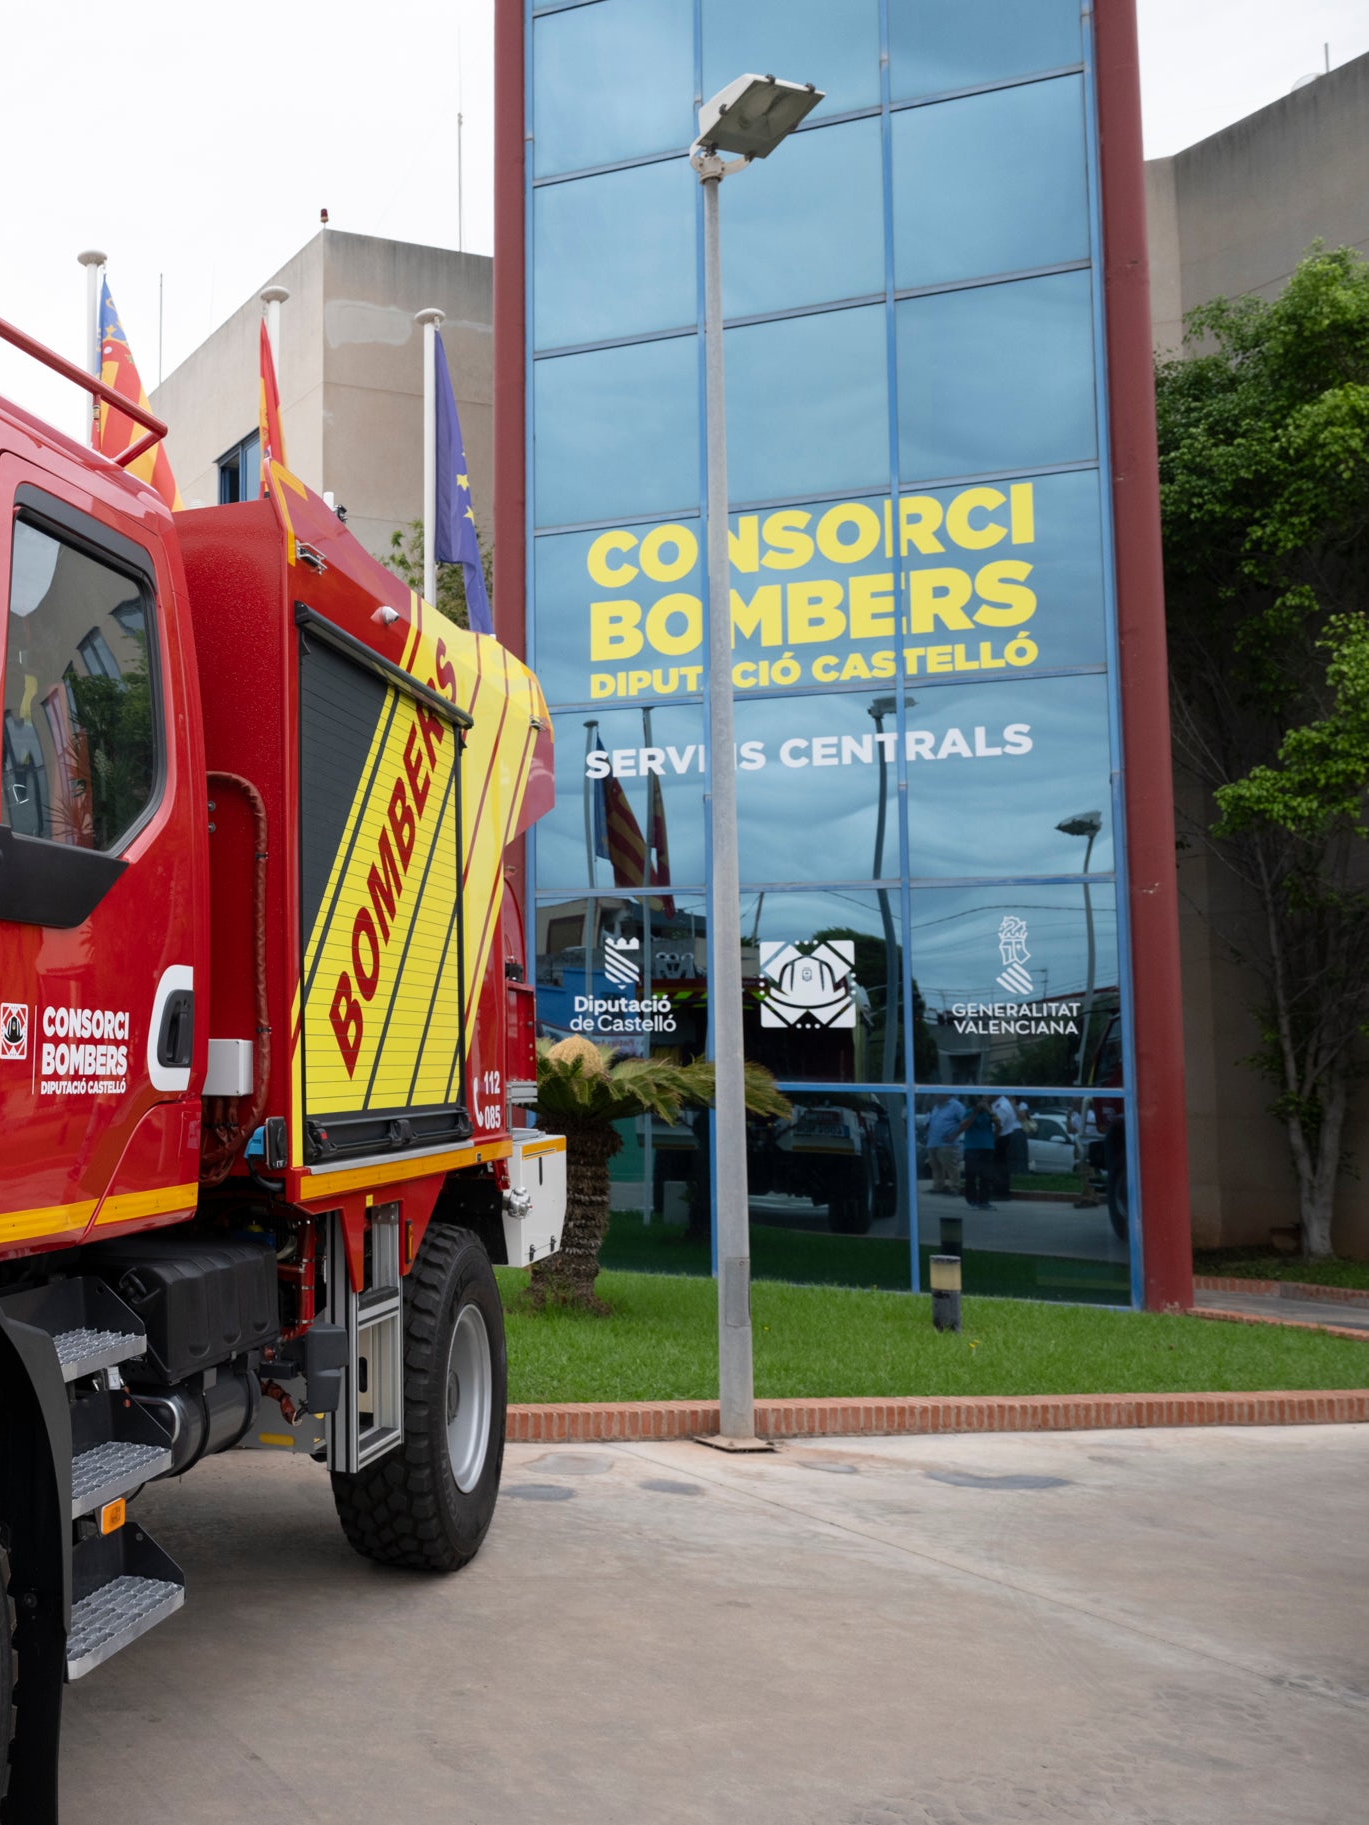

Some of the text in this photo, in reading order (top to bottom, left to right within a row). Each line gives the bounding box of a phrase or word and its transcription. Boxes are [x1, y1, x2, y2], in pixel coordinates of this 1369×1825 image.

[587, 483, 1035, 588] CONSORCI
[590, 559, 1038, 661] BOMBERS
[590, 631, 1039, 699] DIPUTCIÓ CASTELLÓ
[780, 724, 1033, 769] CENTRALS
[329, 636, 457, 1081] BOMBERS
[574, 994, 671, 1015] Diputació
[952, 1002, 1080, 1017] GENERALITAT
[42, 1006, 130, 1040] CONSORCI
[570, 1014, 677, 1032] de Castelló
[954, 1020, 1078, 1035] VALENCIANA
[41, 1043, 128, 1076] BOMBERS
[40, 1077, 127, 1095] DIPUTACIÓ CASTELLÓ
[484, 1070, 501, 1095] 112
[484, 1104, 501, 1130] 085
